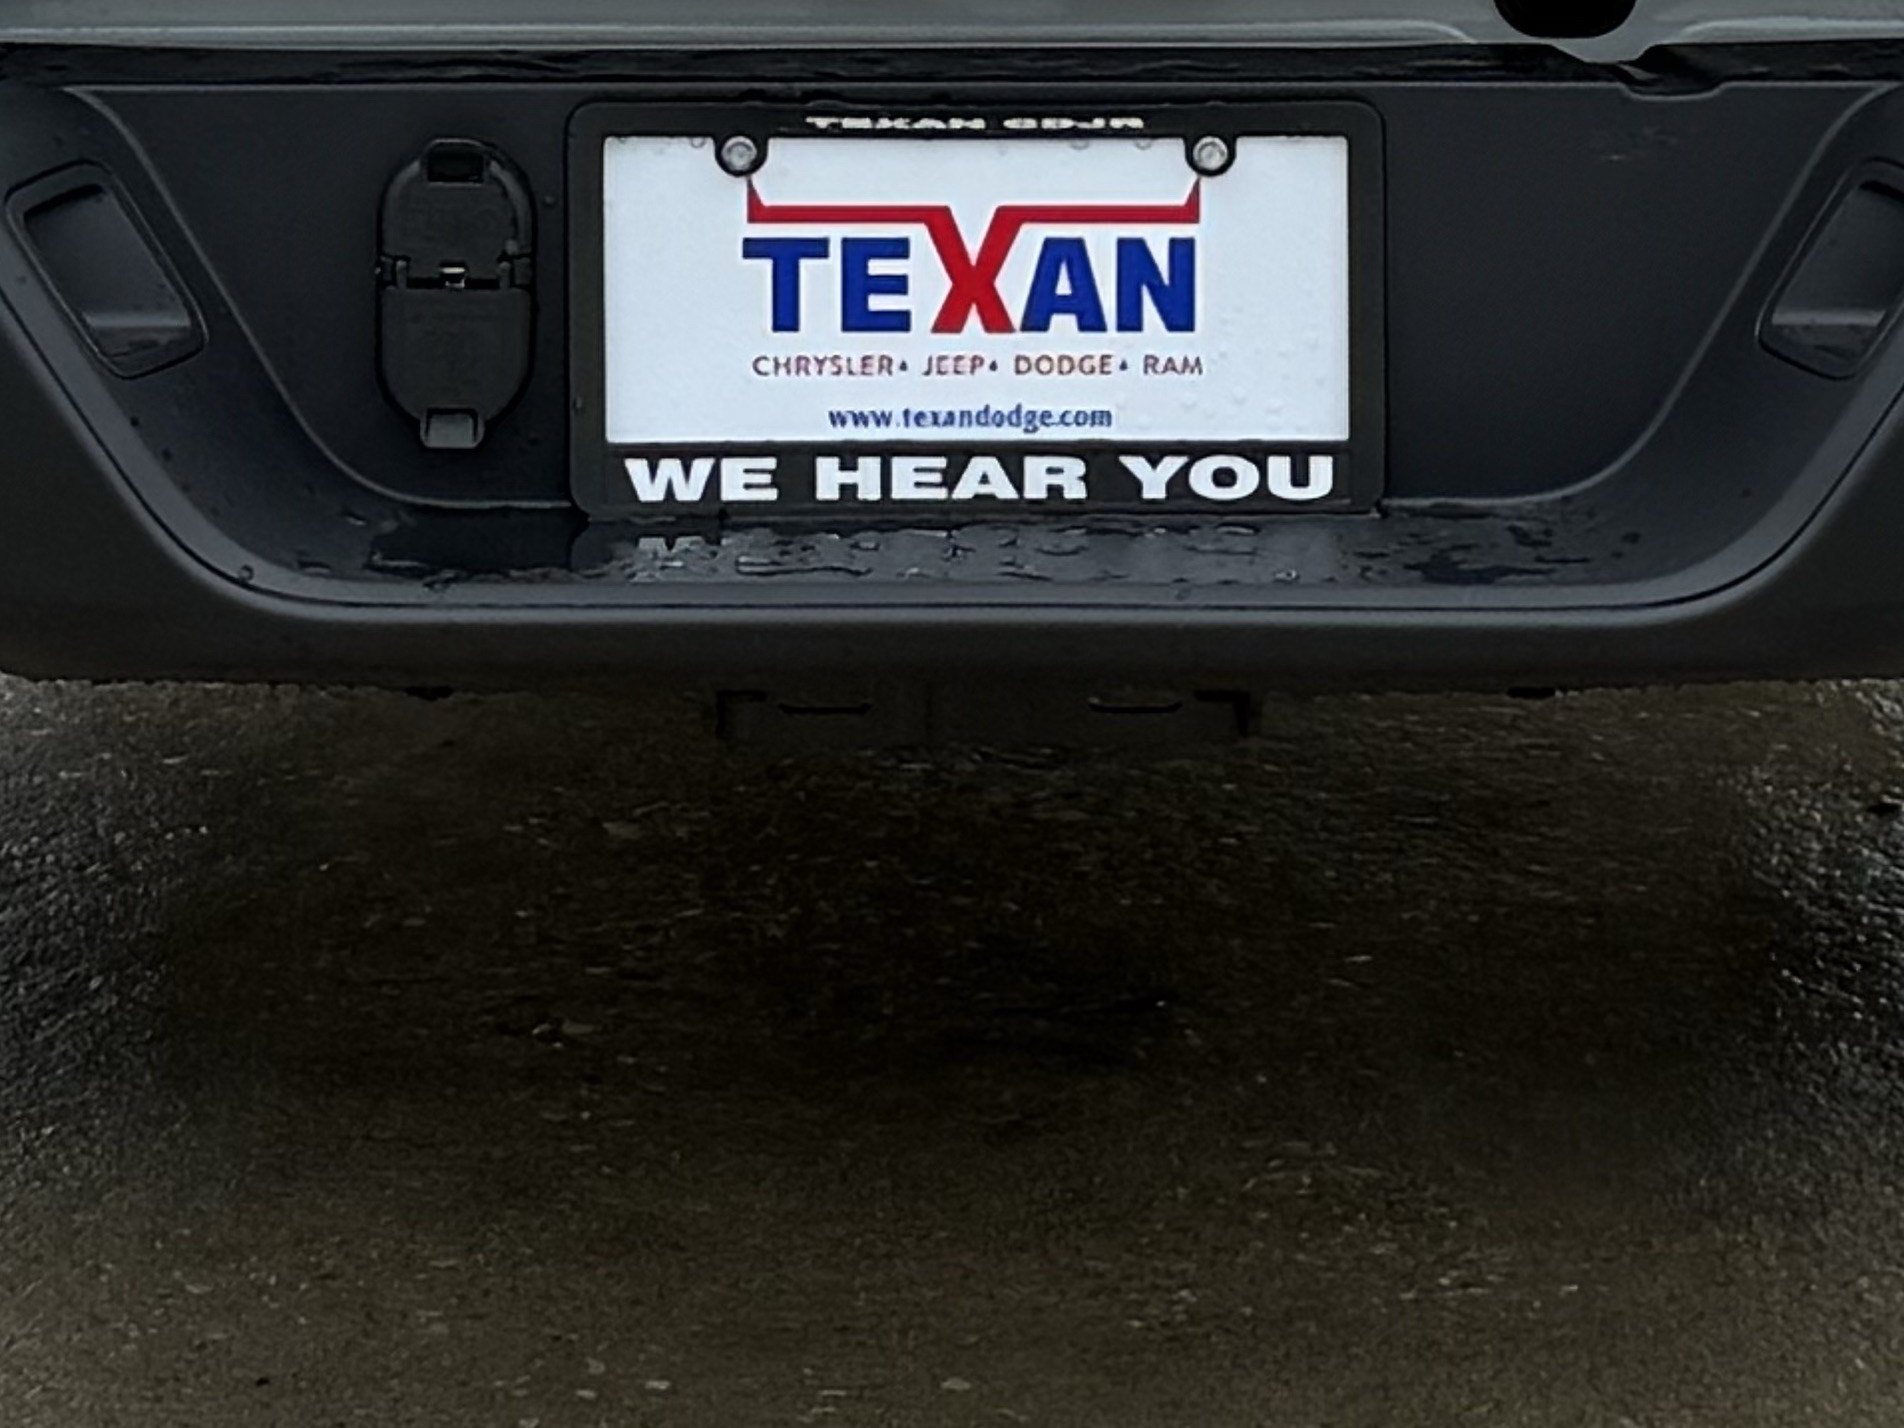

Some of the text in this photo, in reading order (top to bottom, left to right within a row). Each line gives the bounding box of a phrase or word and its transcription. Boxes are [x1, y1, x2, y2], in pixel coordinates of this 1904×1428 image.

[742, 204, 1198, 335] TEXAN
[1143, 354, 1204, 377] RAM
[827, 403, 1113, 433] www.texandodge.com
[624, 454, 1336, 502] WE HEAR YOU
